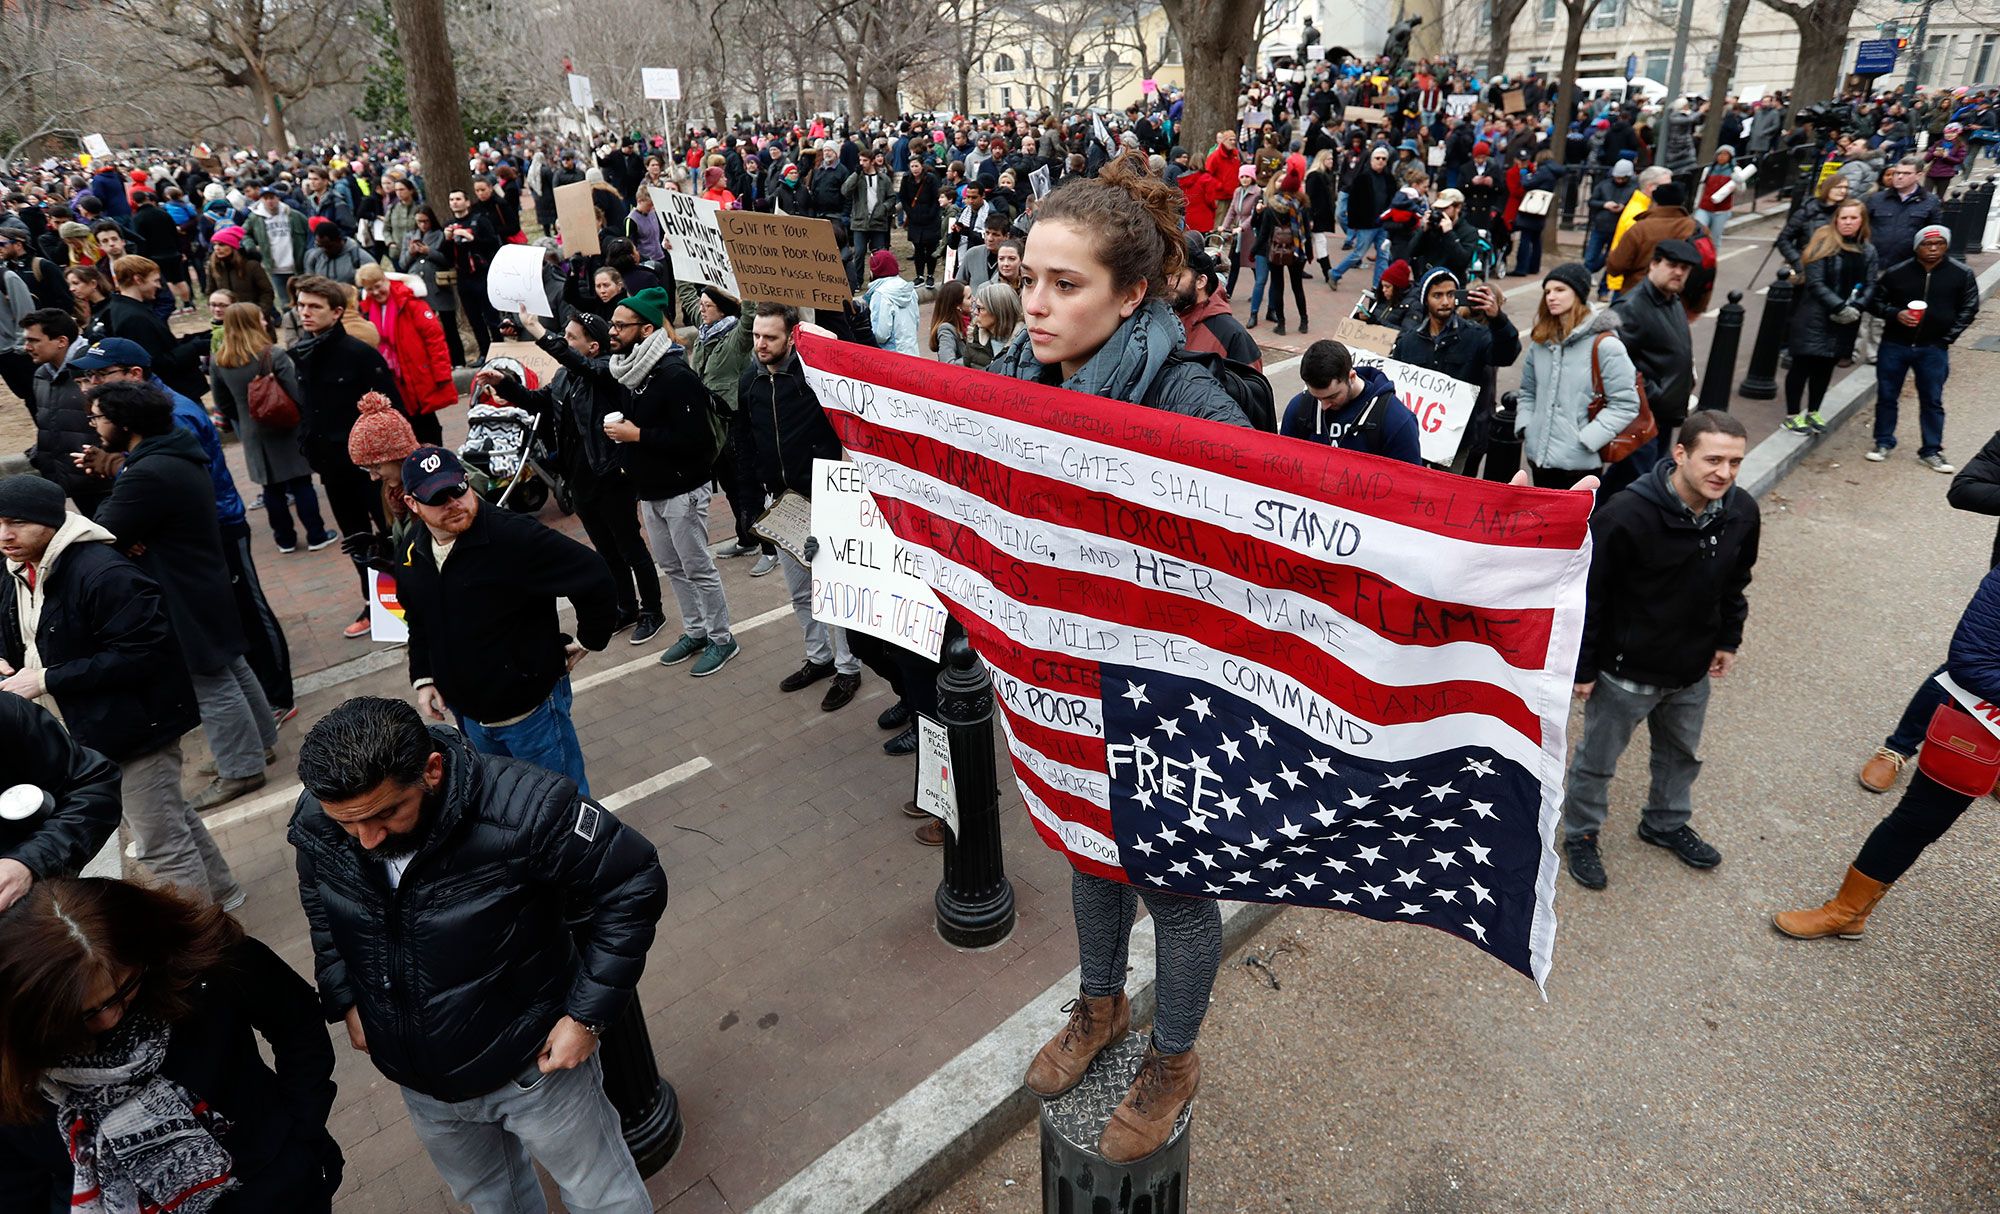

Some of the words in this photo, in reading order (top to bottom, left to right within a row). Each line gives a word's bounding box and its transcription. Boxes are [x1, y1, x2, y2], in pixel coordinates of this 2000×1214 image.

[671, 194, 699, 219] OUR
[662, 211, 725, 252] HUMANITY
[763, 223, 778, 236] ME
[782, 225, 810, 239] YOUR
[682, 238, 696, 258] IS
[694, 243, 709, 261] ON
[707, 247, 729, 273] THE
[758, 243, 780, 257] YOUR
[812, 249, 838, 264] YOUR
[699, 262, 729, 290] LINE
[734, 260, 777, 276] HUDDLED
[780, 265, 814, 281] MASSES
[816, 270, 849, 287] YEARNING
[742, 282, 759, 295] TO
[759, 283, 806, 300] BREATHE
[1398, 364, 1457, 399] RACISM
[835, 379, 880, 419] OUR
[986, 426, 1050, 464] SUNSET
[1060, 447, 1135, 486] GATES
[1151, 470, 1243, 519] SHALL
[1252, 499, 1362, 557] STAND
[1169, 423, 1249, 470] ASTRIDE
[1262, 452, 1303, 483] FROM
[1320, 456, 1394, 500] LAND
[860, 500, 886, 530] BA
[829, 536, 881, 571] WE'LL
[930, 442, 1011, 508] WOMAN
[1219, 535, 1340, 599] WHOSE
[1354, 572, 1521, 654] FLAME
[812, 579, 883, 629] BANDING
[1056, 577, 1127, 618] FROM
[1142, 597, 1208, 633] HER
[1080, 545, 1120, 569] AND
[1135, 549, 1223, 605] HER
[1246, 587, 1349, 653] NAME
[998, 596, 1034, 641] HER
[1048, 617, 1120, 651] MILD
[1133, 634, 1209, 671] EYES
[1222, 659, 1373, 745] COMMAND
[925, 788, 940, 801] ONE
[1042, 762, 1104, 801] SHORE
[1106, 743, 1224, 820] FREE
[1081, 835, 1120, 863] DOOR
